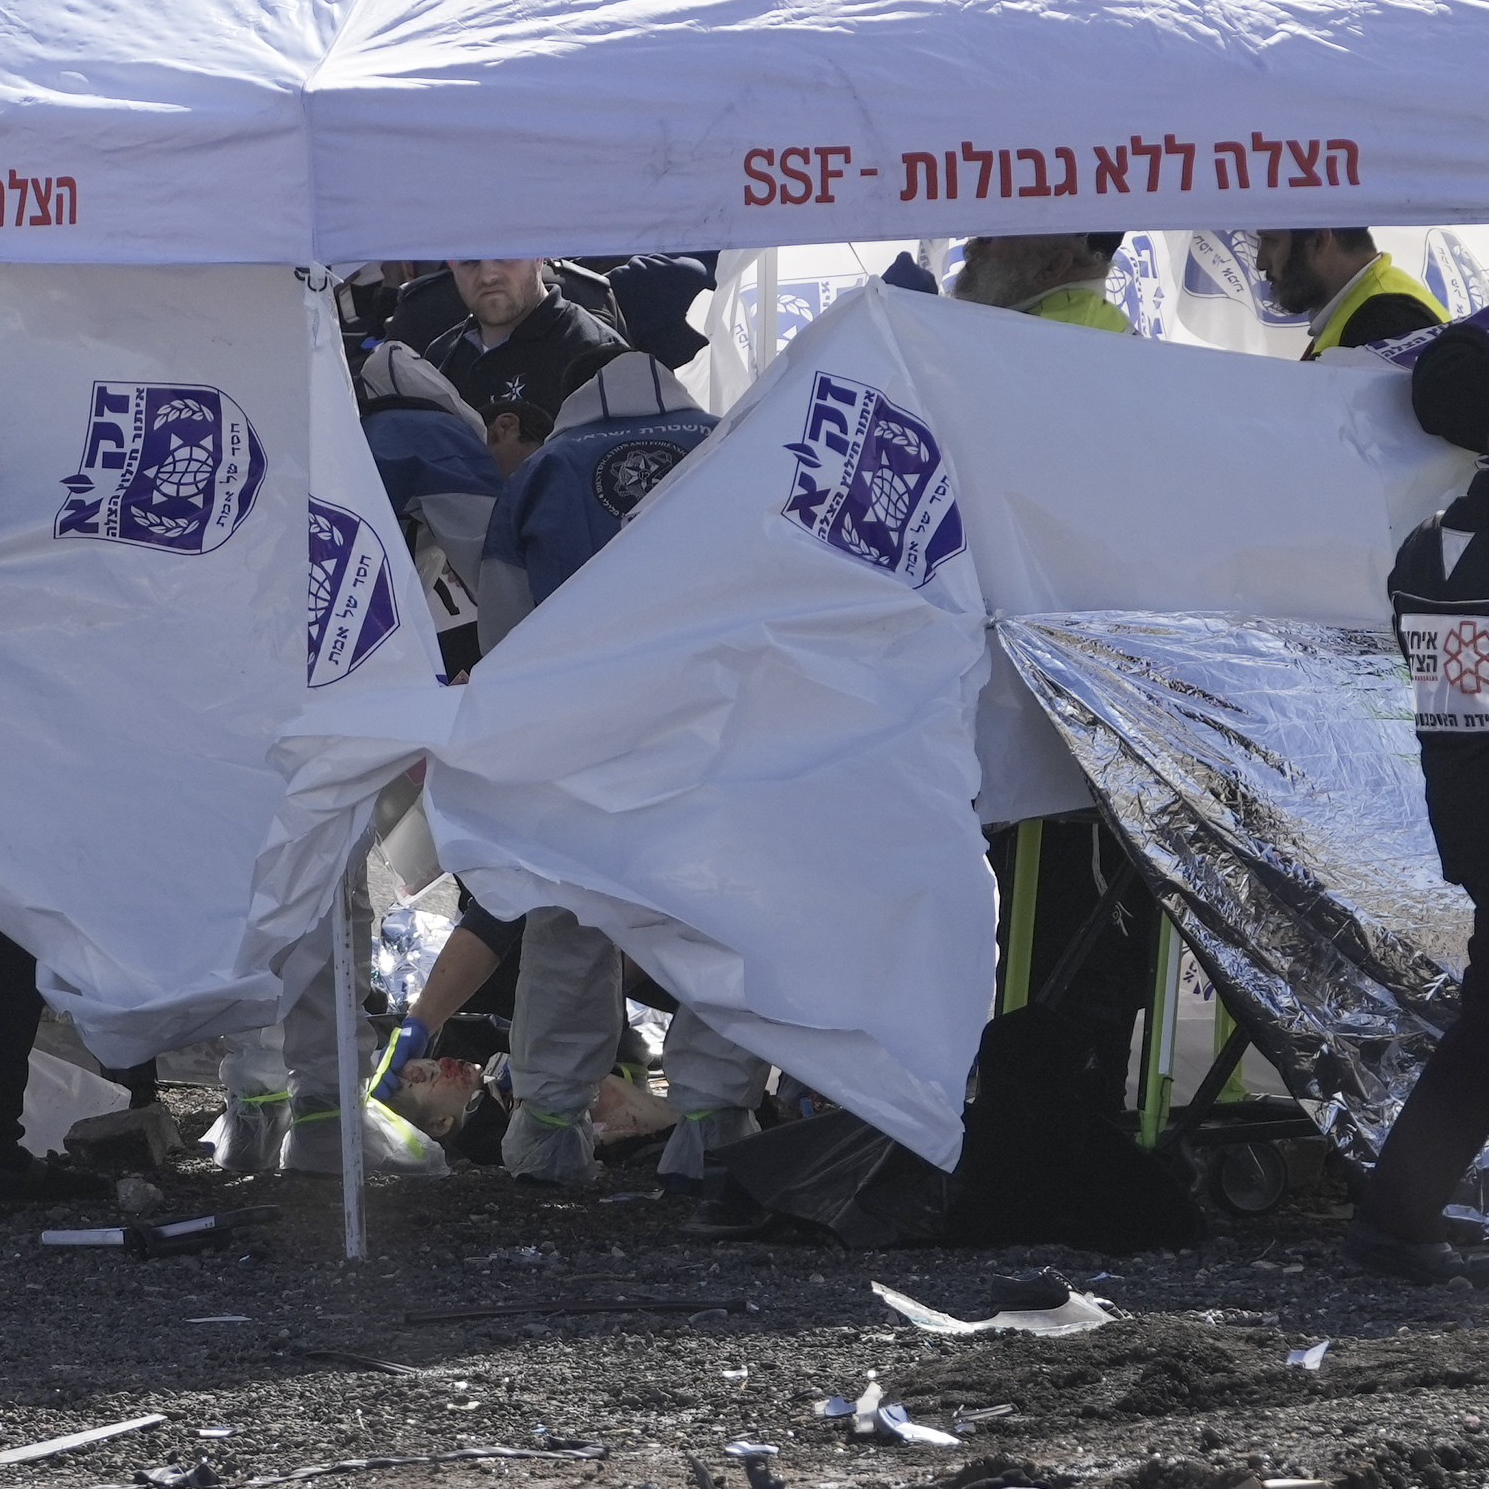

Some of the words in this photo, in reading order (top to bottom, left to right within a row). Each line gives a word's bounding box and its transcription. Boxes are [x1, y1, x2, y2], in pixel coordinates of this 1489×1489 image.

[900, 141, 1078, 202] גבולות
[1093, 133, 1197, 194] ללא
[1214, 131, 1361, 189] הצלה
[132, 387, 145, 443] איתור
[855, 389, 876, 436] איתור
[230, 422, 241, 457] חסד
[115, 448, 139, 492] חילוץ
[219, 463, 239, 485] של
[839, 440, 861, 489] חילוץ
[216, 490, 235, 528] אמת
[929, 474, 951, 505] חסד
[104, 494, 120, 538] הצלה
[817, 491, 844, 541] הצלה
[910, 511, 931, 534] של
[353, 554, 372, 588] חסד
[905, 540, 919, 577] אמת
[335, 595, 358, 618] של
[328, 626, 350, 666] אמת
